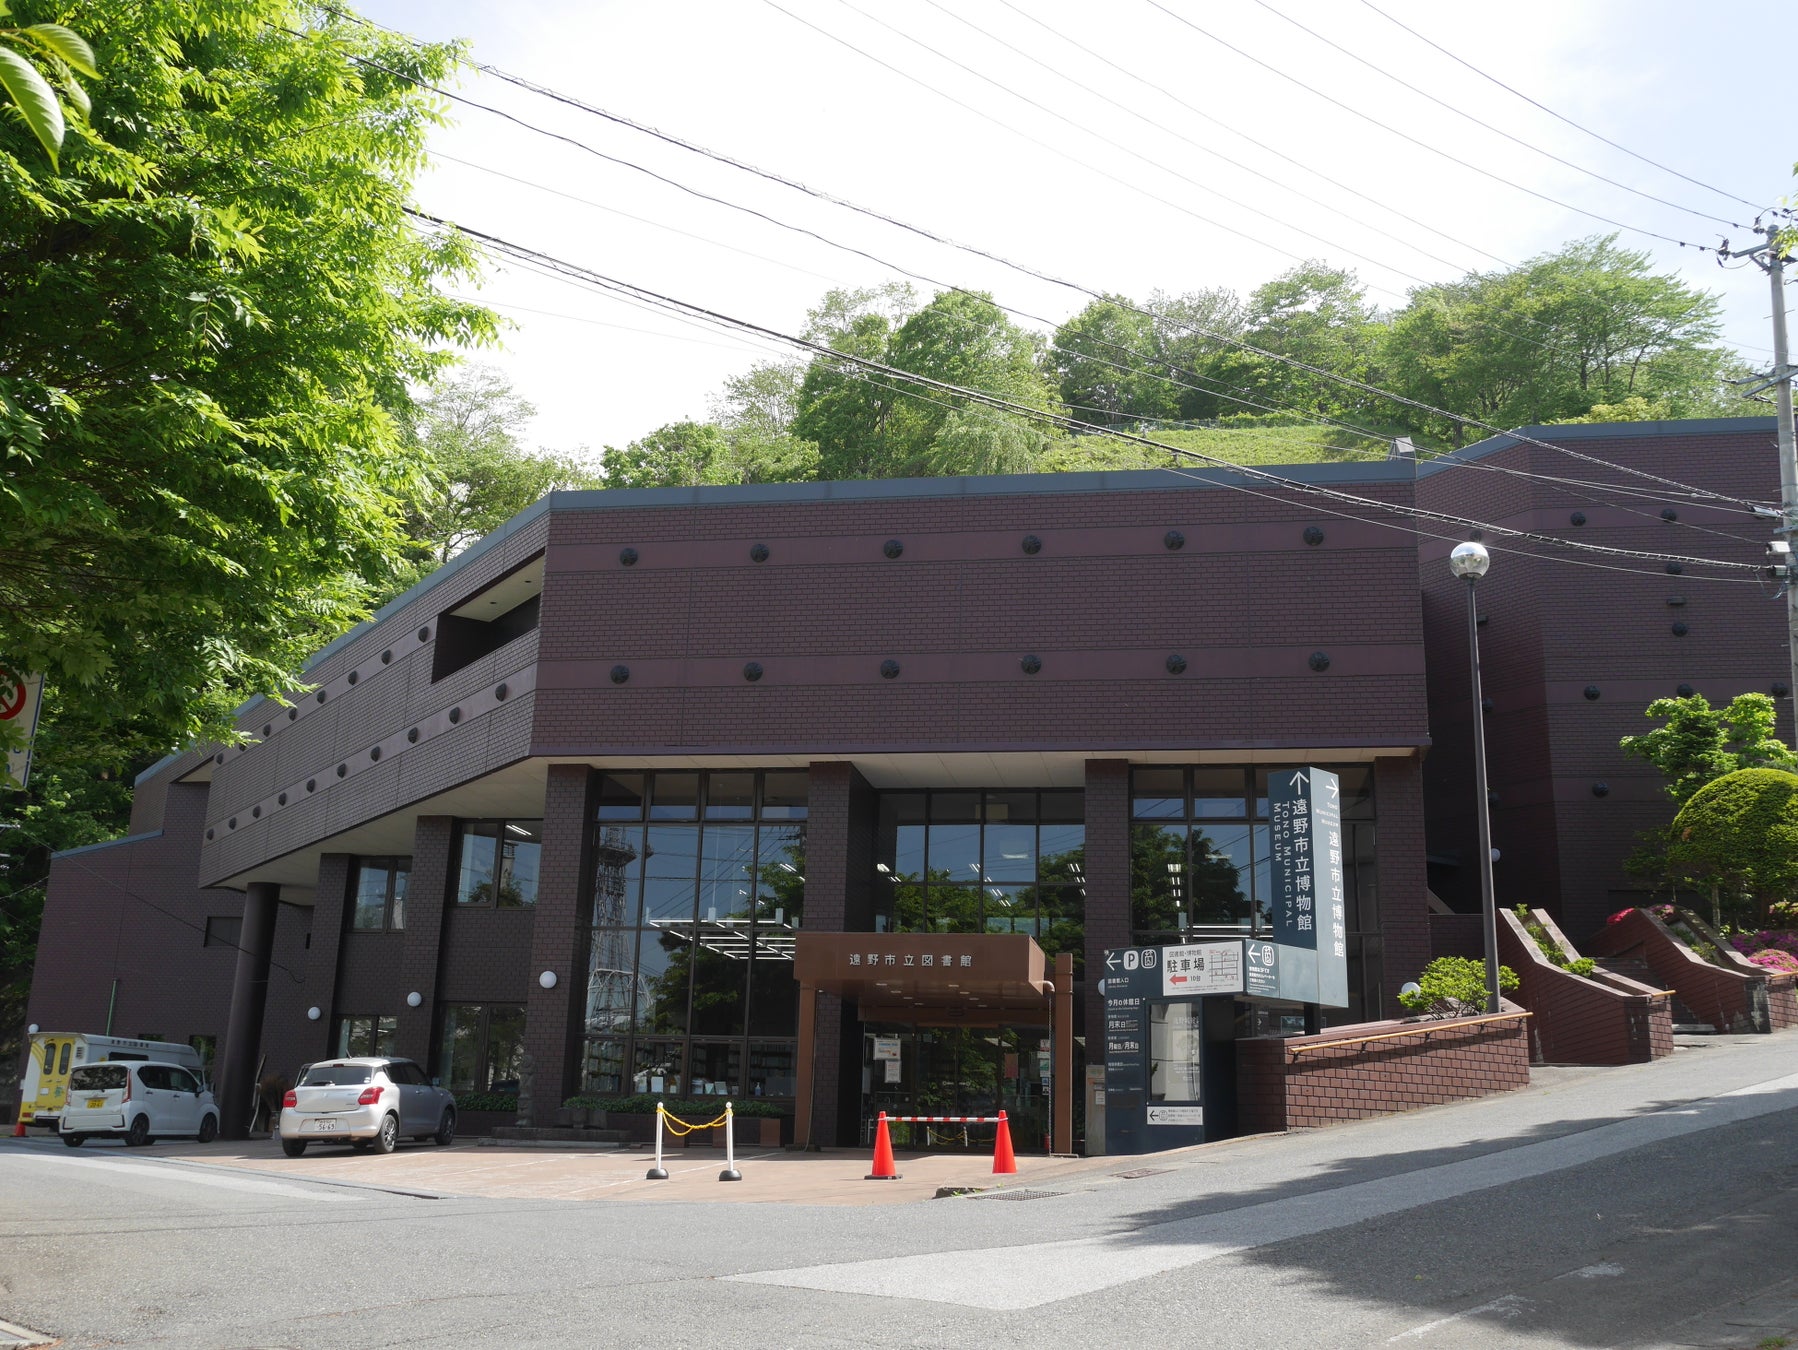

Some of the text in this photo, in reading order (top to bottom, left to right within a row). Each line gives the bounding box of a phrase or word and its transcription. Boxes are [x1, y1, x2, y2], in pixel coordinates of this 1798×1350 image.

[1273, 802, 1282, 862] MUSEUM
[1282, 800, 1293, 927] TONO MUNICIPAL
[1292, 798, 1312, 931] 遠野市立博物館
[1329, 830, 1344, 958] 遠野市立博物館
[849, 953, 972, 967] 遠野市立図書館
[1166, 957, 1205, 974] 駐車場
